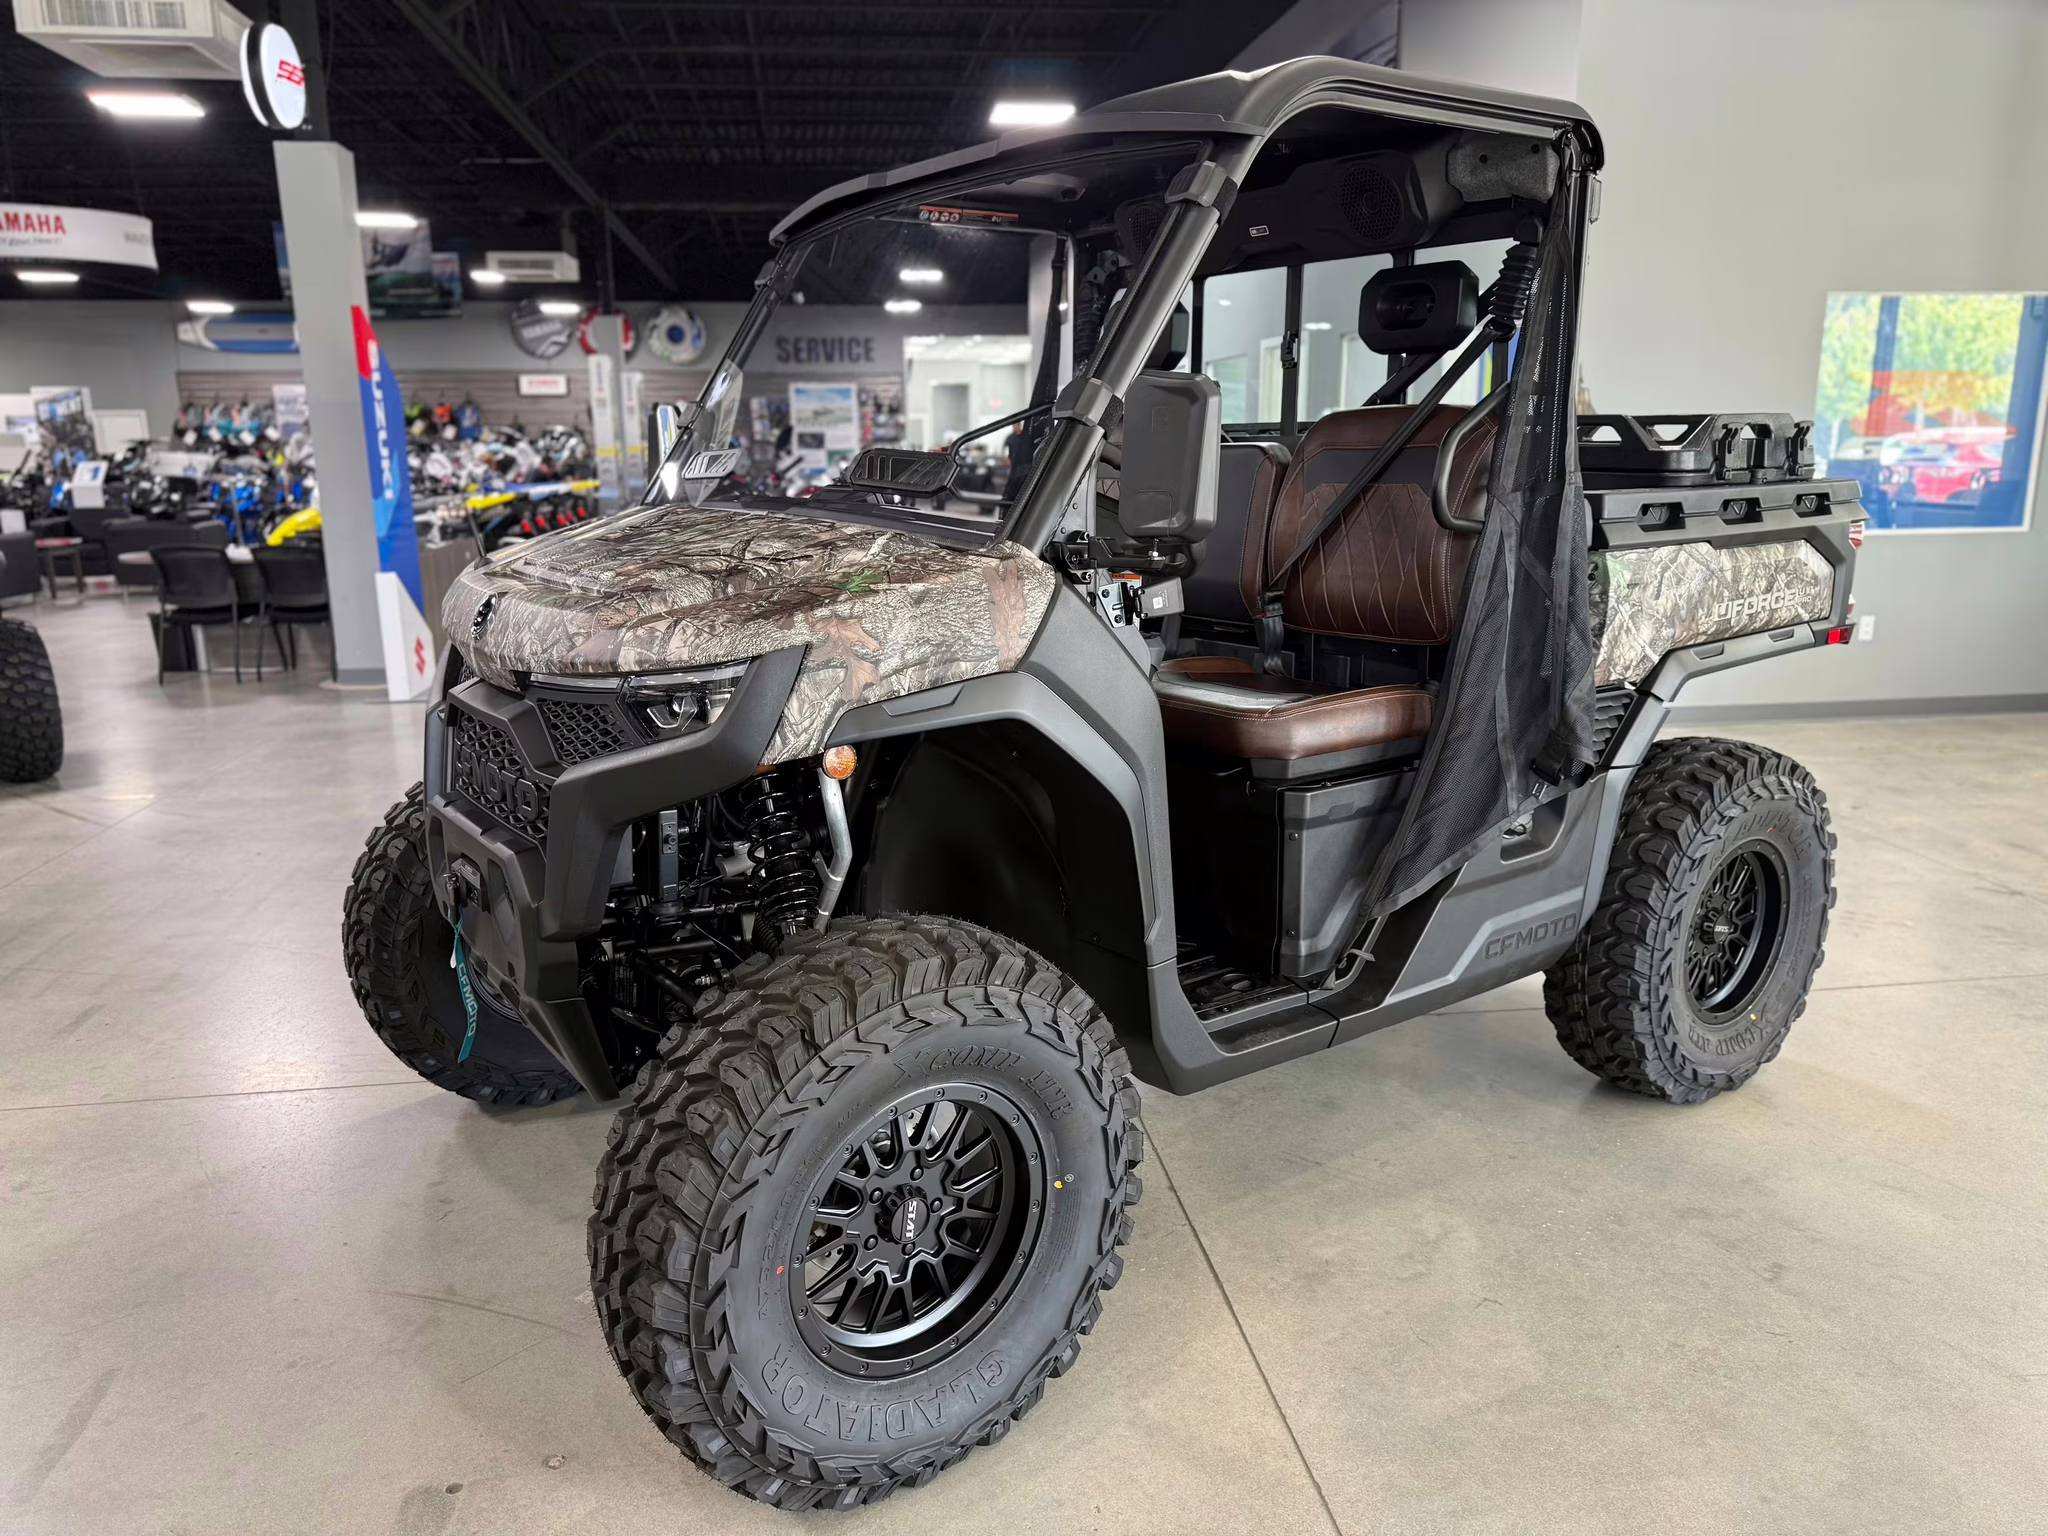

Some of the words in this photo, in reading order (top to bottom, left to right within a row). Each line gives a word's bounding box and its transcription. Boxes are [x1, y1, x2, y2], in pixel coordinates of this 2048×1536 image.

[775, 335, 876, 364] SERVICE
[367, 339, 394, 499] SUZUKI
[1484, 912, 1577, 960] CFMOTO
[458, 962, 478, 1037] CFMOTO
[929, 1043, 1025, 1072] COMP
[761, 1343, 1008, 1442] GLADIATOR
